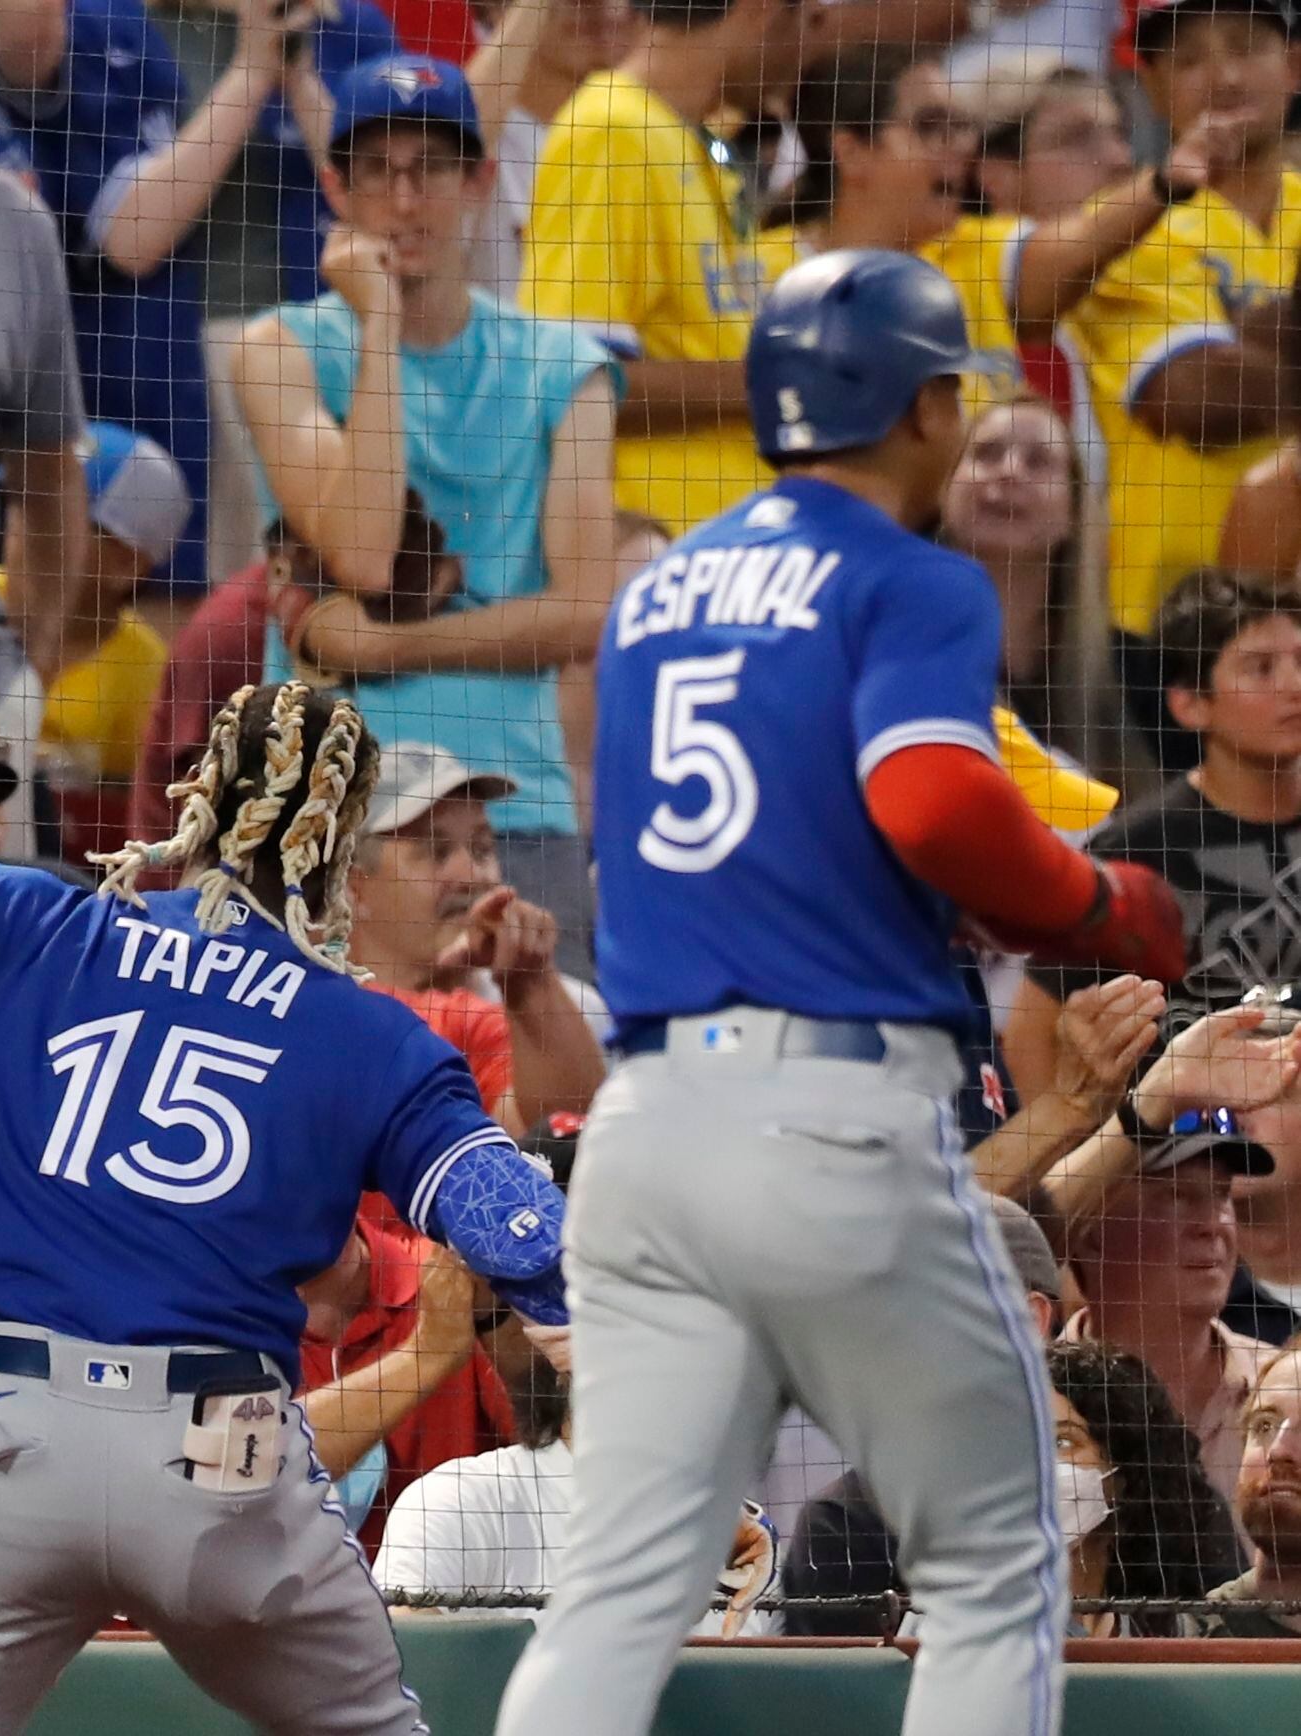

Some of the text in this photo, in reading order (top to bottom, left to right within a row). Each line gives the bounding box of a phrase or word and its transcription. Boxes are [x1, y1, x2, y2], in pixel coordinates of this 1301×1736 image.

[616, 546, 841, 650] ESPINAL
[637, 647, 759, 874] 5
[115, 917, 307, 1020] TAPIA
[38, 1009, 284, 1205] 15
